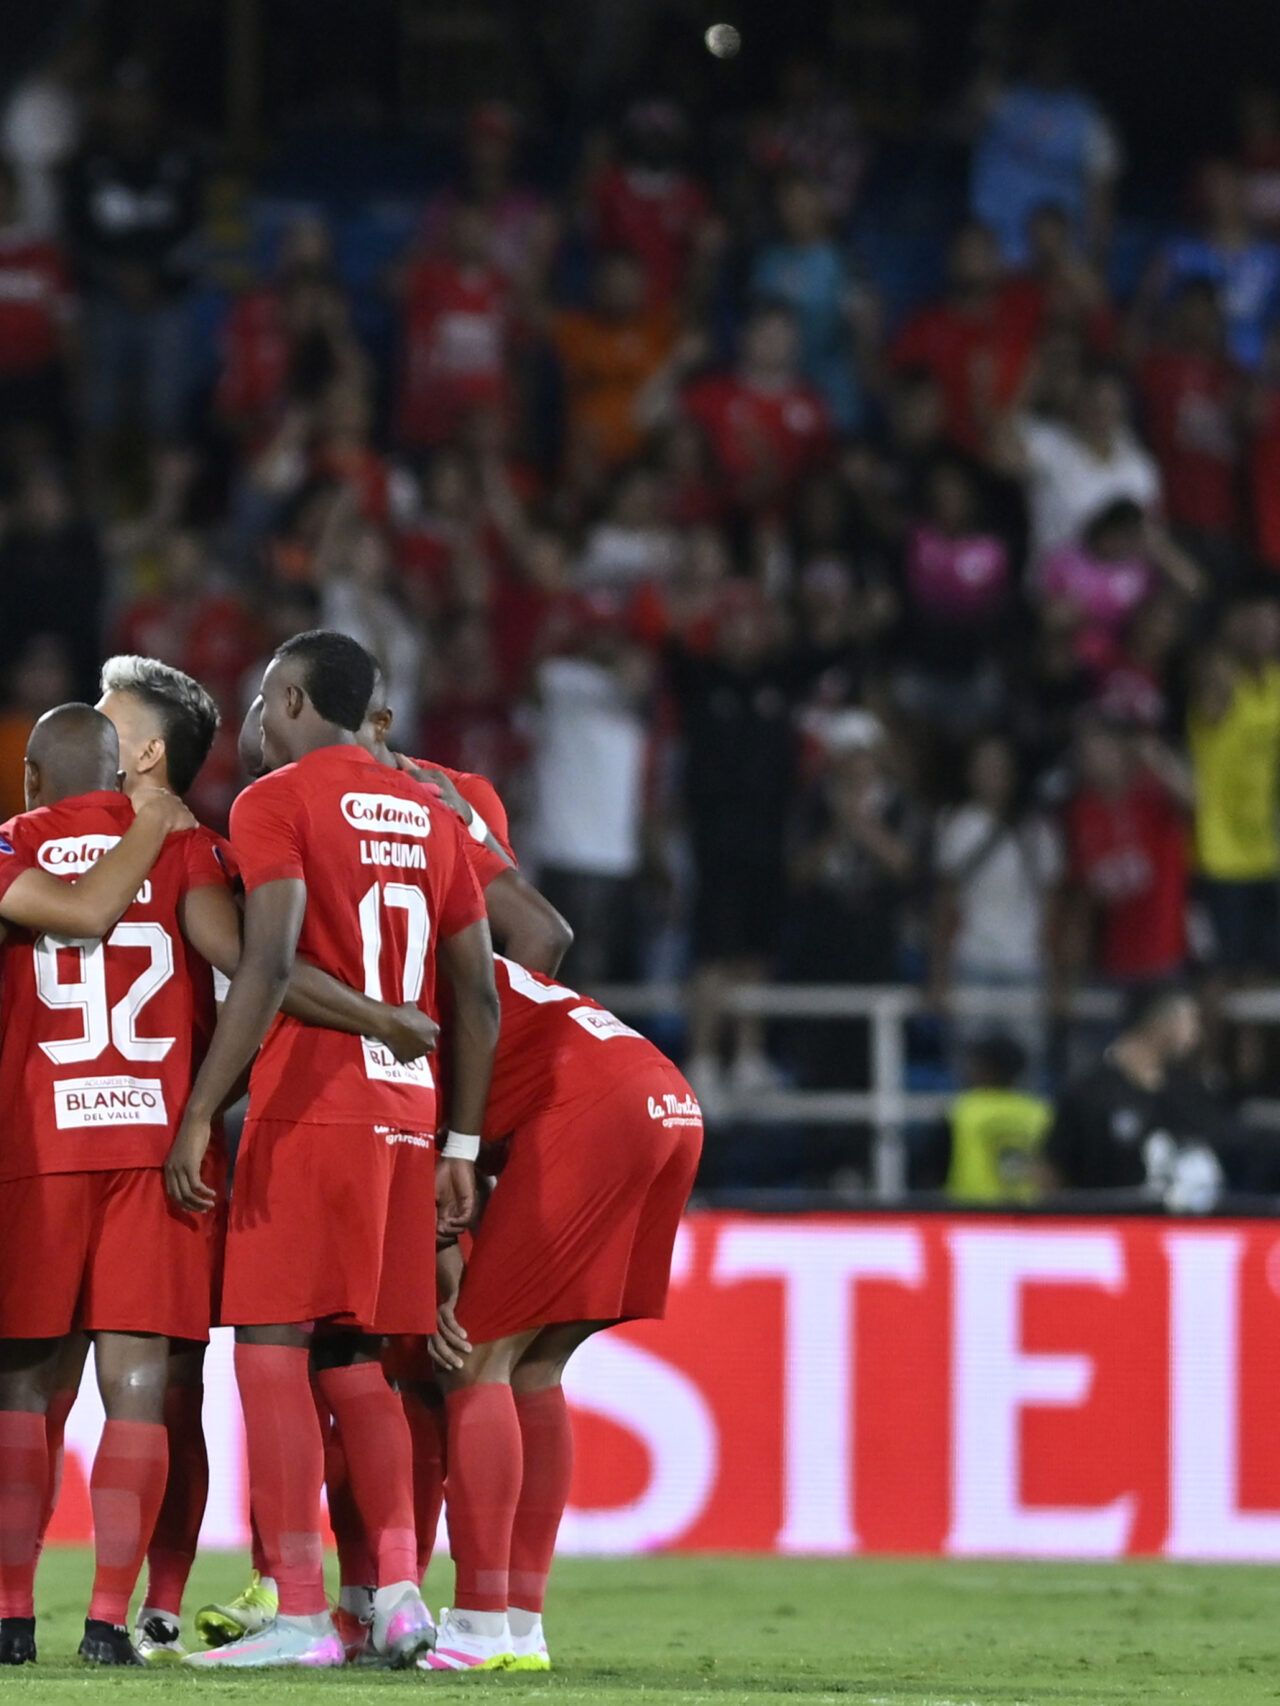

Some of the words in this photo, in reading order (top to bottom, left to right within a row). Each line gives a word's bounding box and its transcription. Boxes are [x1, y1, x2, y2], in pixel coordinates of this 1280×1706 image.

[345, 799, 426, 828] Colanta
[358, 880, 431, 1004] 17
[33, 921, 177, 1066] 92
[66, 1090, 157, 1111] BLANCO
[83, 1112, 104, 1121] DEL
[107, 1110, 140, 1120] VALLE
